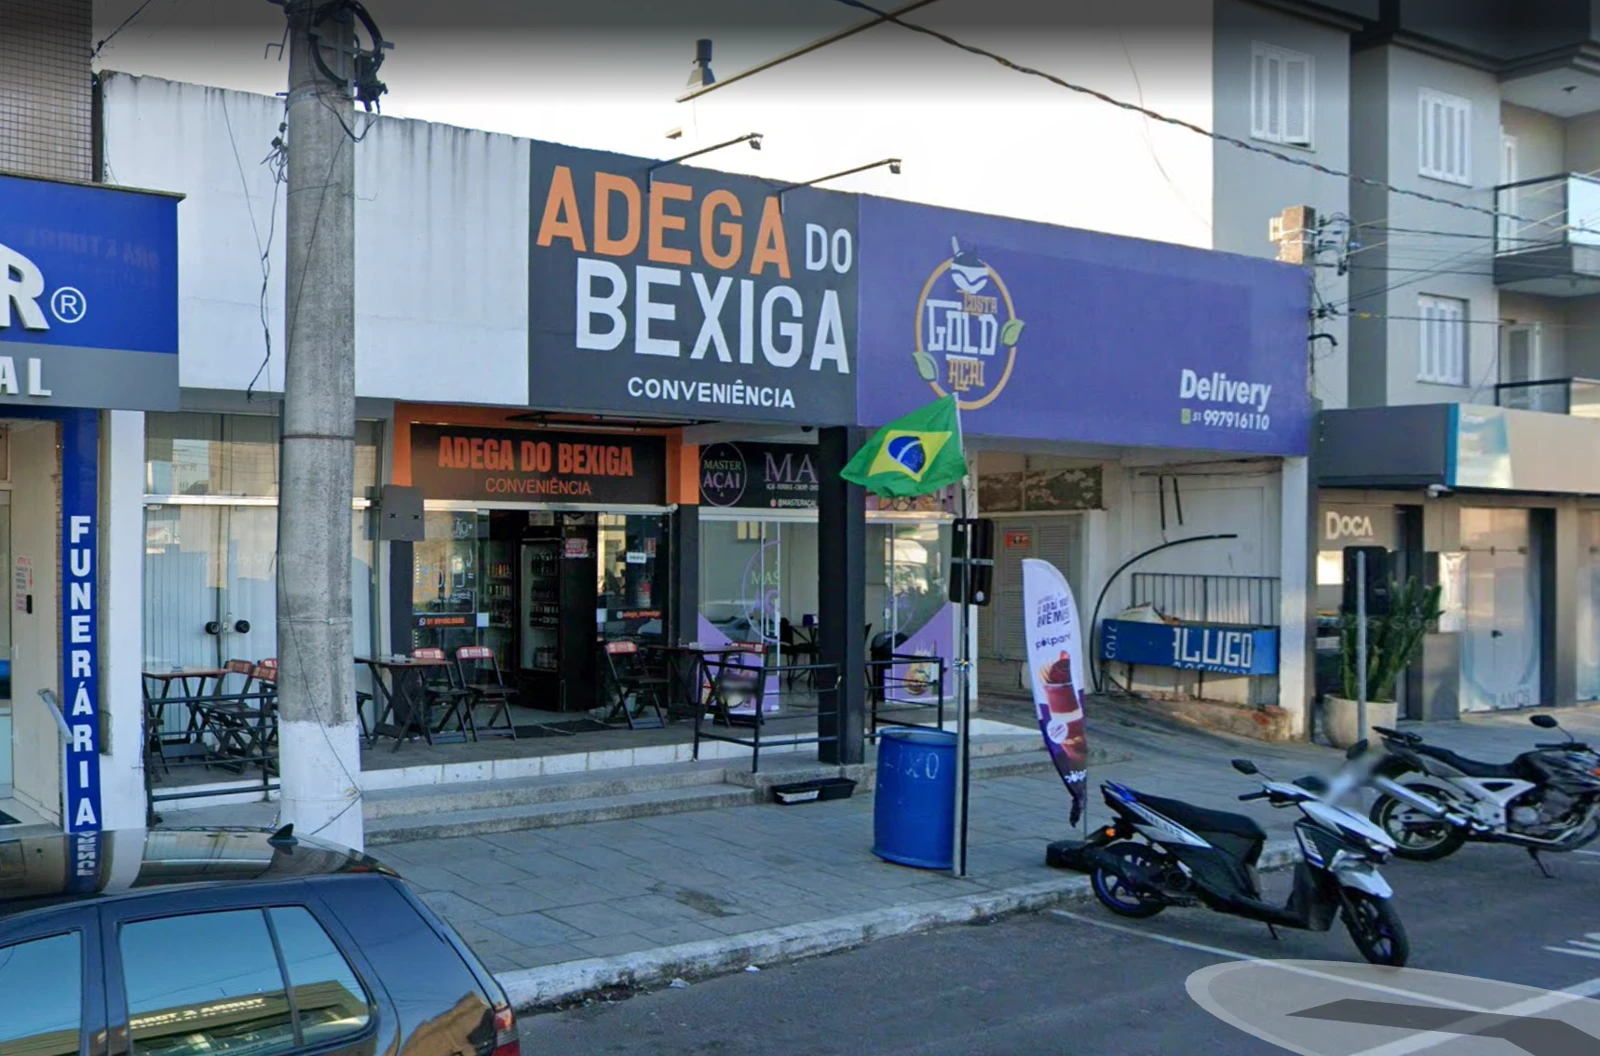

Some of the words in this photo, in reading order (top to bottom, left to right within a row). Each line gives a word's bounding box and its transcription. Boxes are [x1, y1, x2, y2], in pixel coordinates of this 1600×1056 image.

[536, 165, 792, 279] ADEGA
[805, 223, 853, 274] DO
[576, 257, 850, 374] BEXIGA
[926, 299, 999, 356] GOLD
[627, 375, 796, 410] CONVENIÊNCIA
[1180, 368, 1273, 412] Delivery
[1203, 409, 1271, 432] 997916110
[438, 435, 514, 472] ADEGA
[520, 441, 553, 473] DO
[558, 443, 634, 477] BEXIGA
[703, 459, 742, 471] MASTER
[485, 477, 592, 496] CONVENIÊNCIA
[69, 516, 98, 826] FUNERÁRIA
